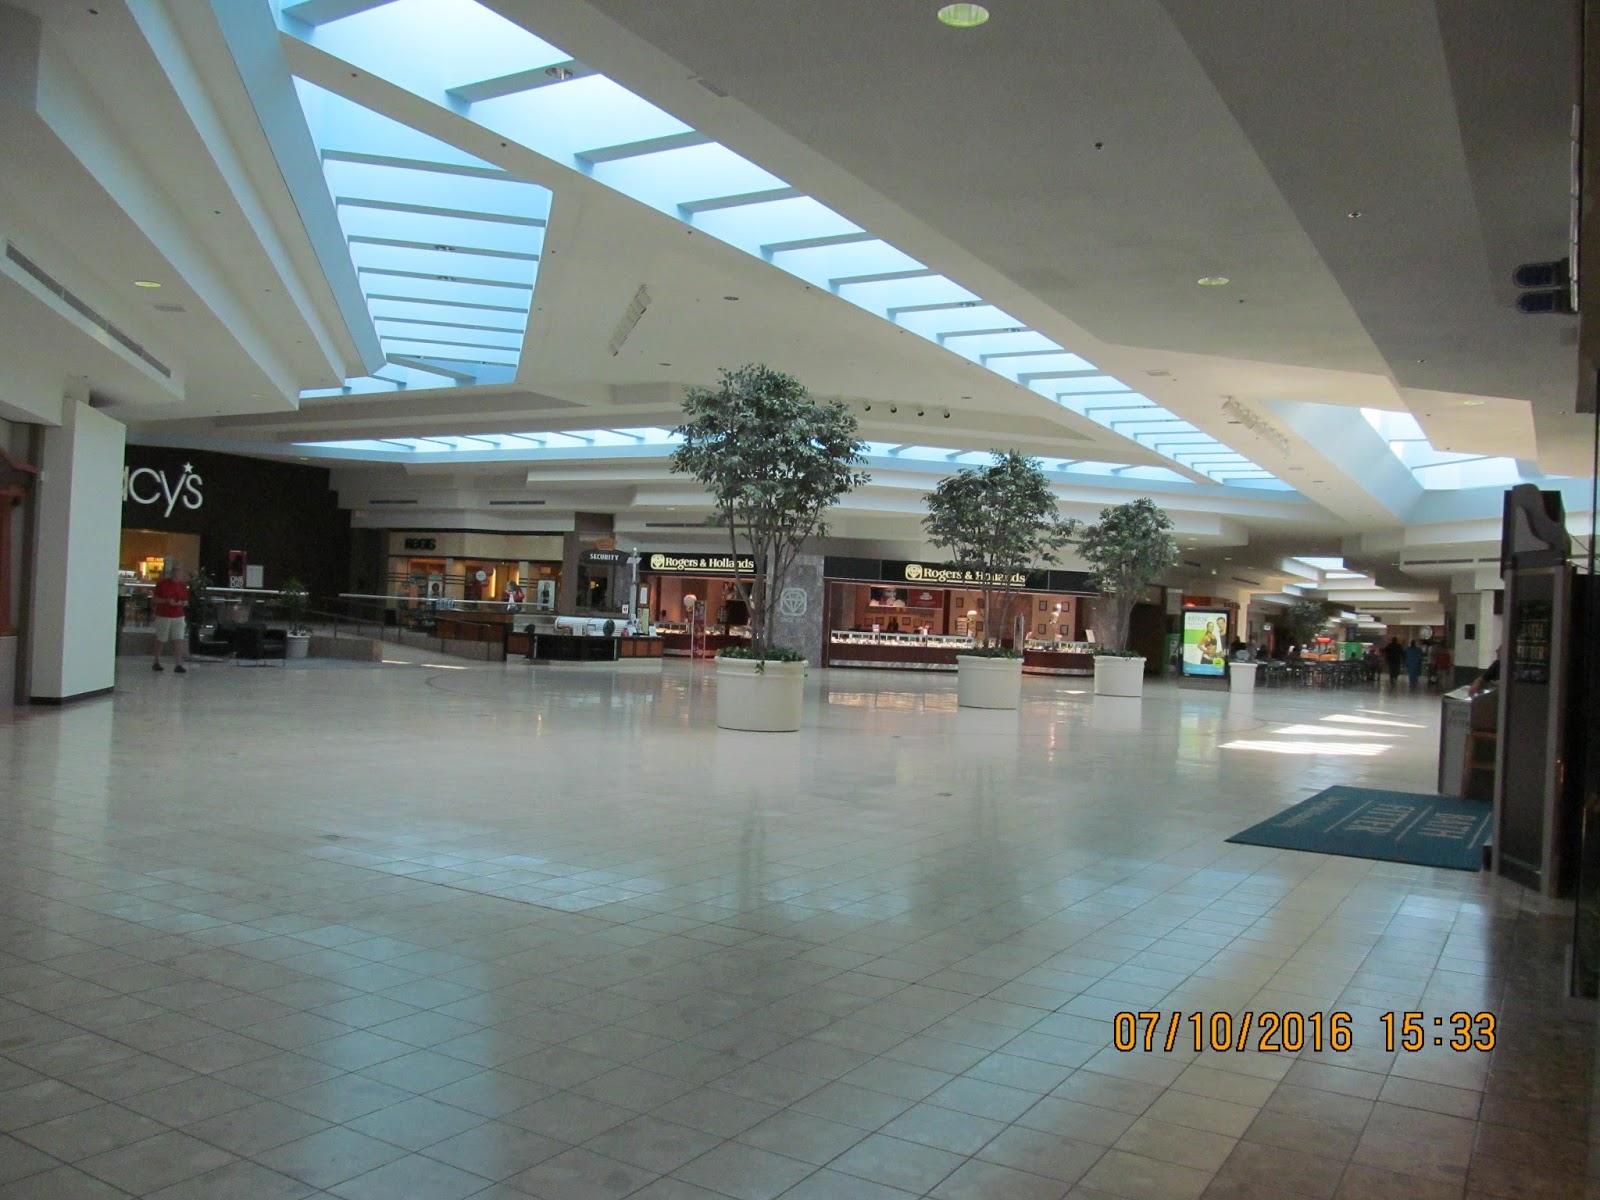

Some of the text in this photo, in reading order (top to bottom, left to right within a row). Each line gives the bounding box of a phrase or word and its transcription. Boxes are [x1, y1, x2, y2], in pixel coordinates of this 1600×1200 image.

[589, 552, 620, 562] SECURITY
[665, 557, 698, 571] Rogers
[699, 558, 707, 567] &
[923, 567, 962, 582] Rogers
[964, 571, 973, 580] &
